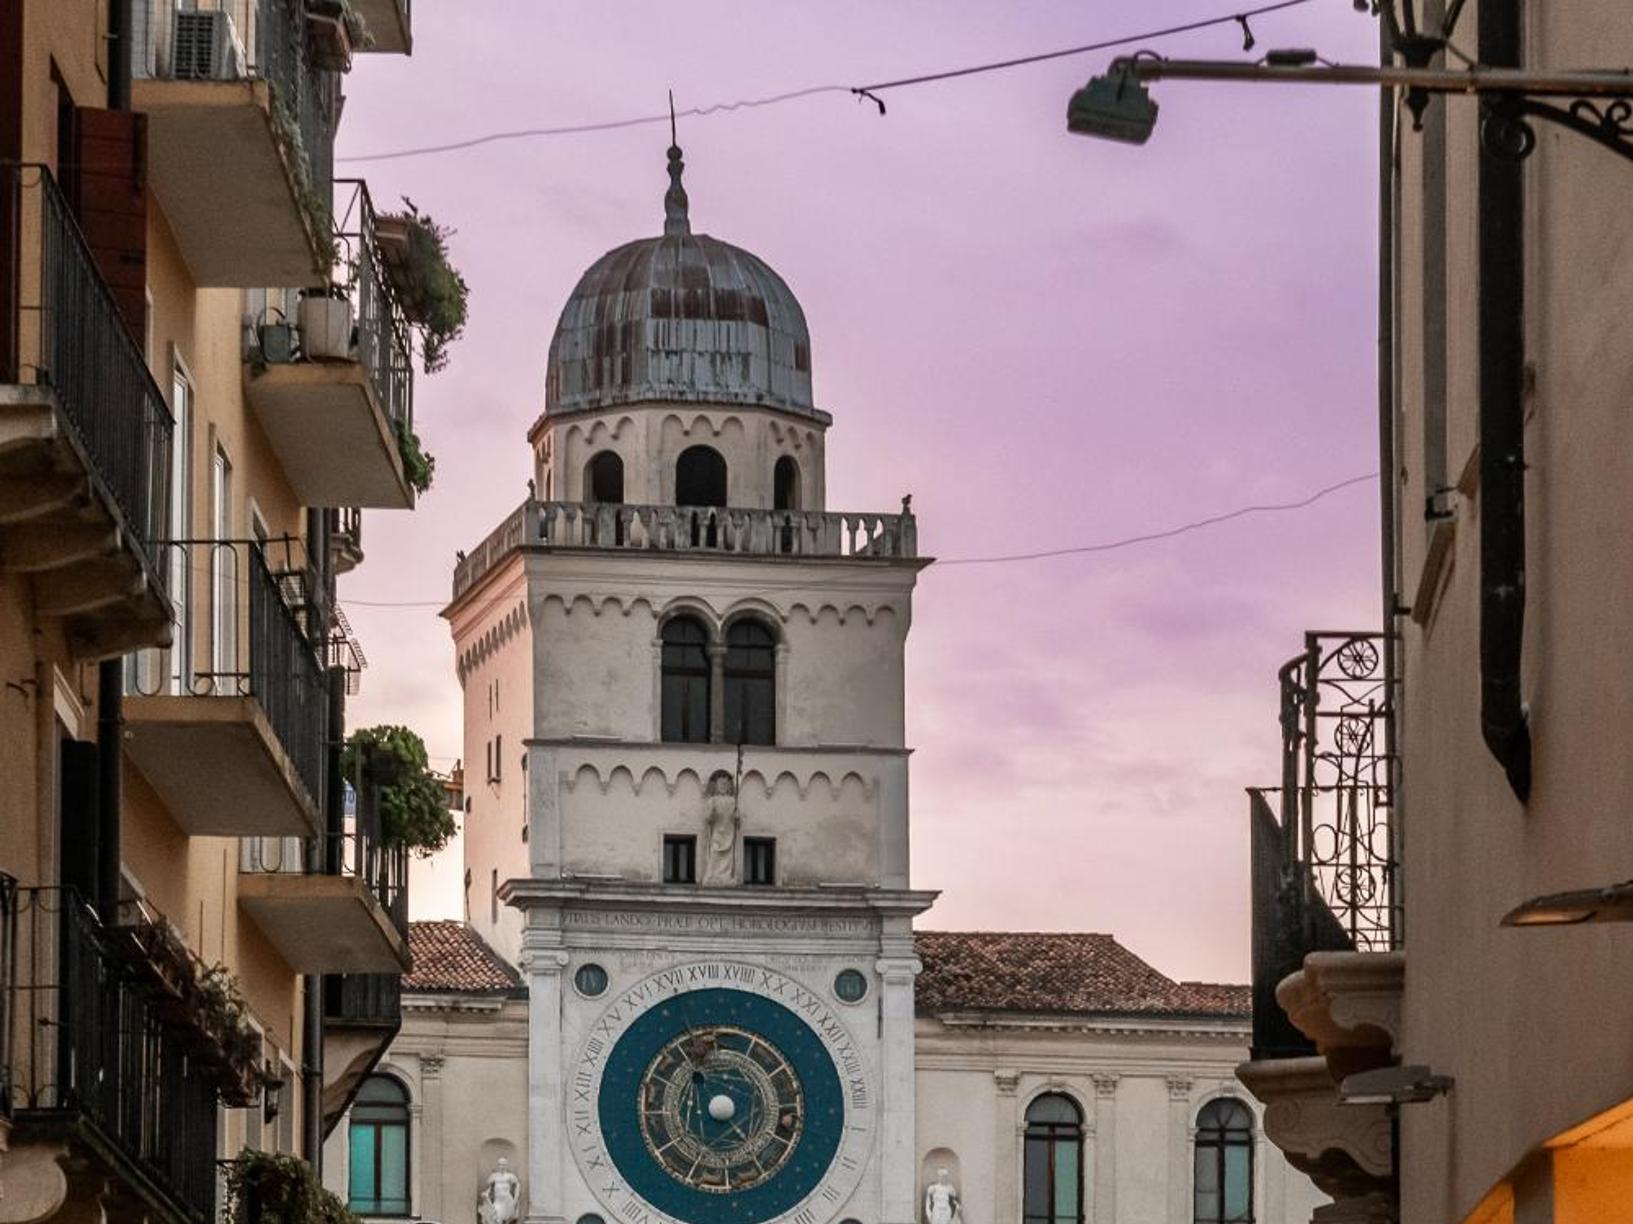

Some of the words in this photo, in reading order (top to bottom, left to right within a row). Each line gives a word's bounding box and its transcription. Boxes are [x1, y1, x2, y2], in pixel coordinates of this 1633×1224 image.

[653, 969, 683, 992] XVII
[687, 964, 719, 981] XVIII
[759, 972, 789, 995] XX
[623, 984, 652, 1010] XVI
[791, 988, 821, 1016] XXI
[597, 1007, 622, 1037] XV
[818, 1012, 845, 1043] XXII
[575, 1071, 592, 1101] XIII
[574, 1111, 592, 1136] XII
[582, 1145, 604, 1170] XI
[842, 1156, 857, 1171] II
[602, 1181, 620, 1198] X
[822, 1186, 841, 1202] III
